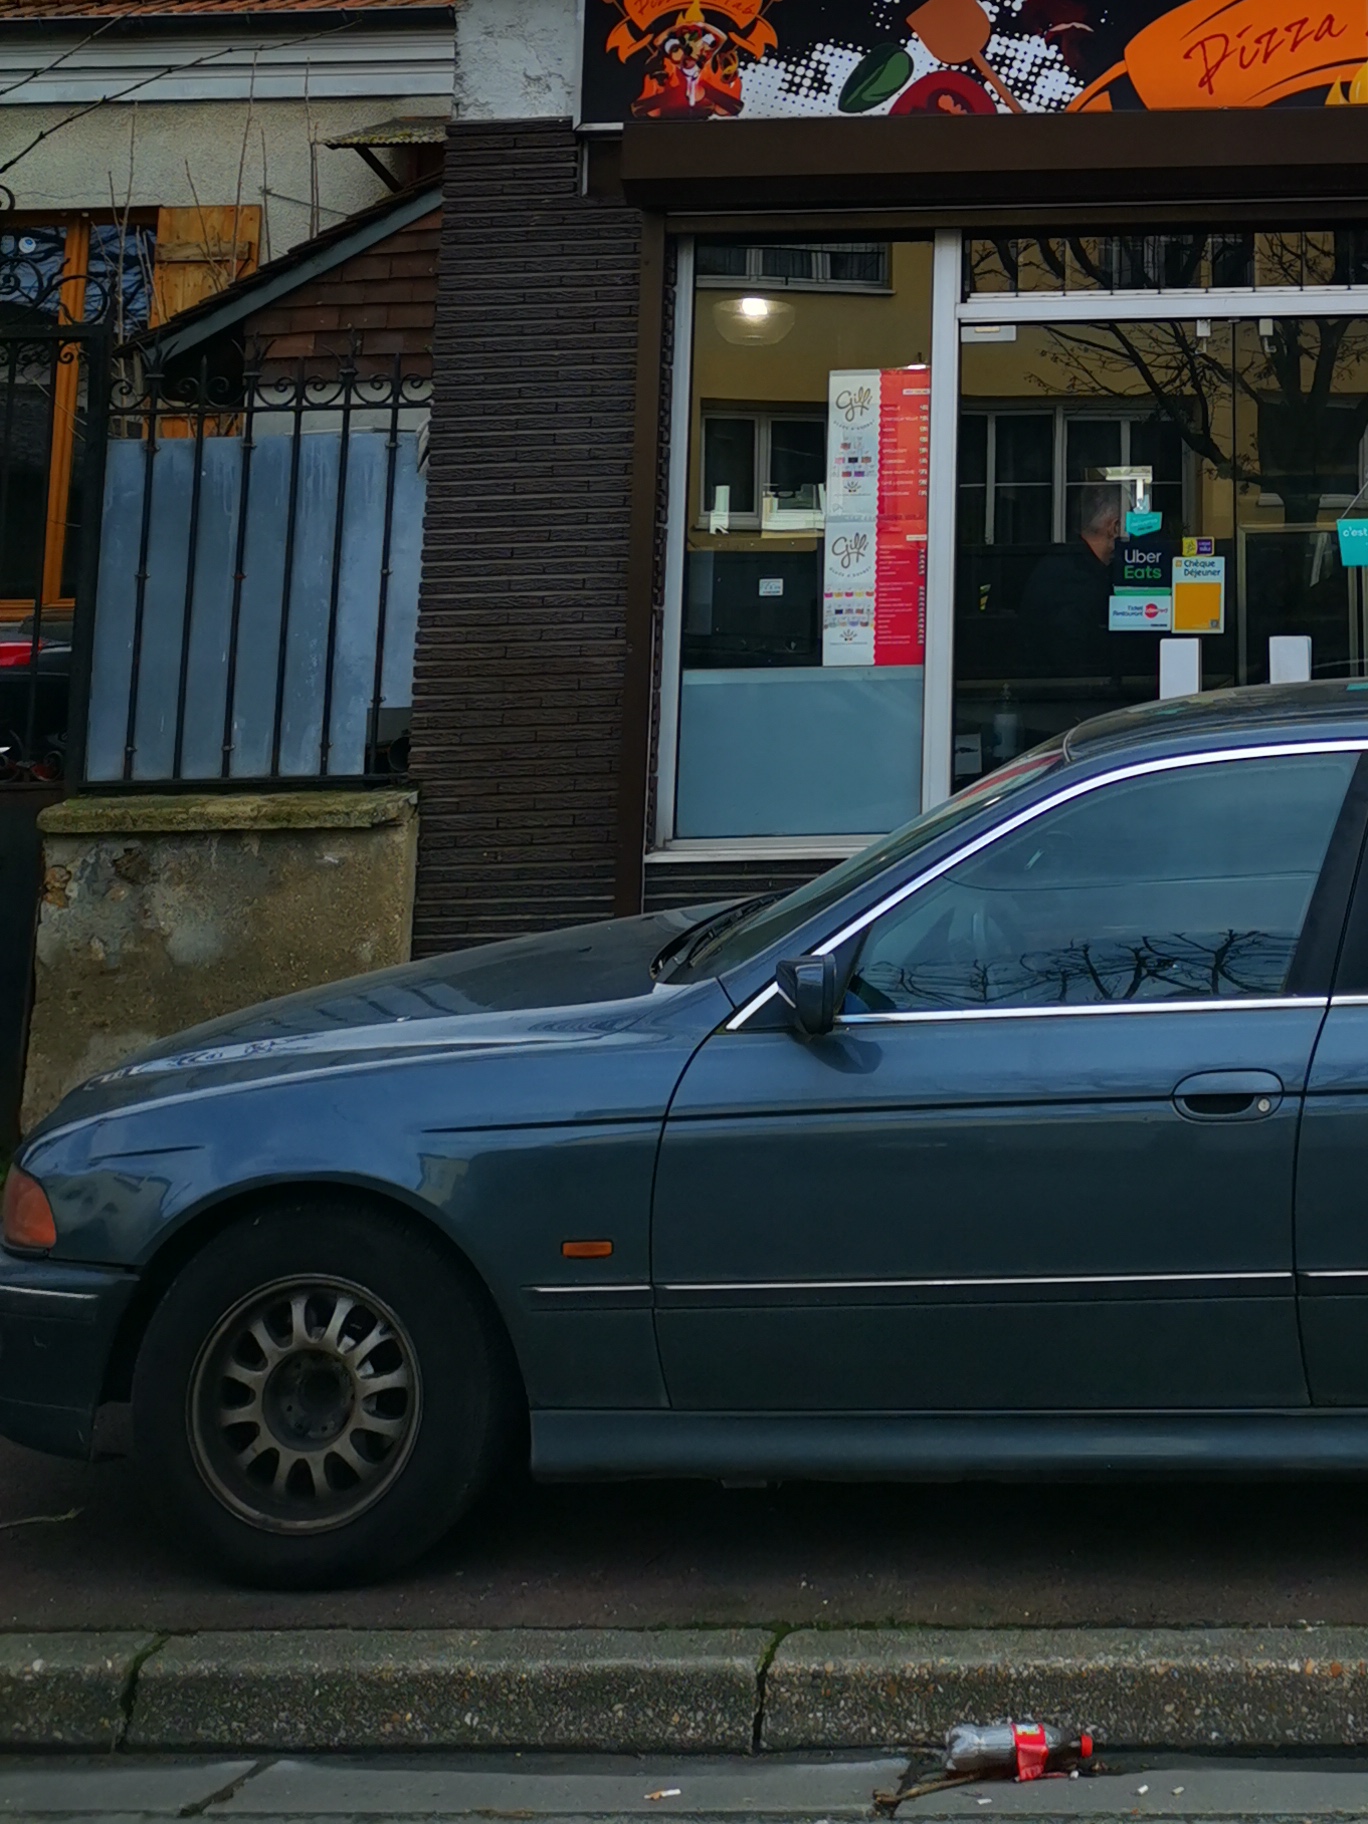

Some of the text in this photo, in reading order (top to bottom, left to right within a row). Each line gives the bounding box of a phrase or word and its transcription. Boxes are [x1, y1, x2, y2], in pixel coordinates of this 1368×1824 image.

[1182, 13, 1348, 95] Pizza
[1342, 526, 1368, 537] c'est
[1124, 548, 1162, 564] Uber
[1183, 559, 1215, 570] Chèque
[1124, 565, 1162, 579] Eats
[1183, 568, 1221, 578] Déjeuner
